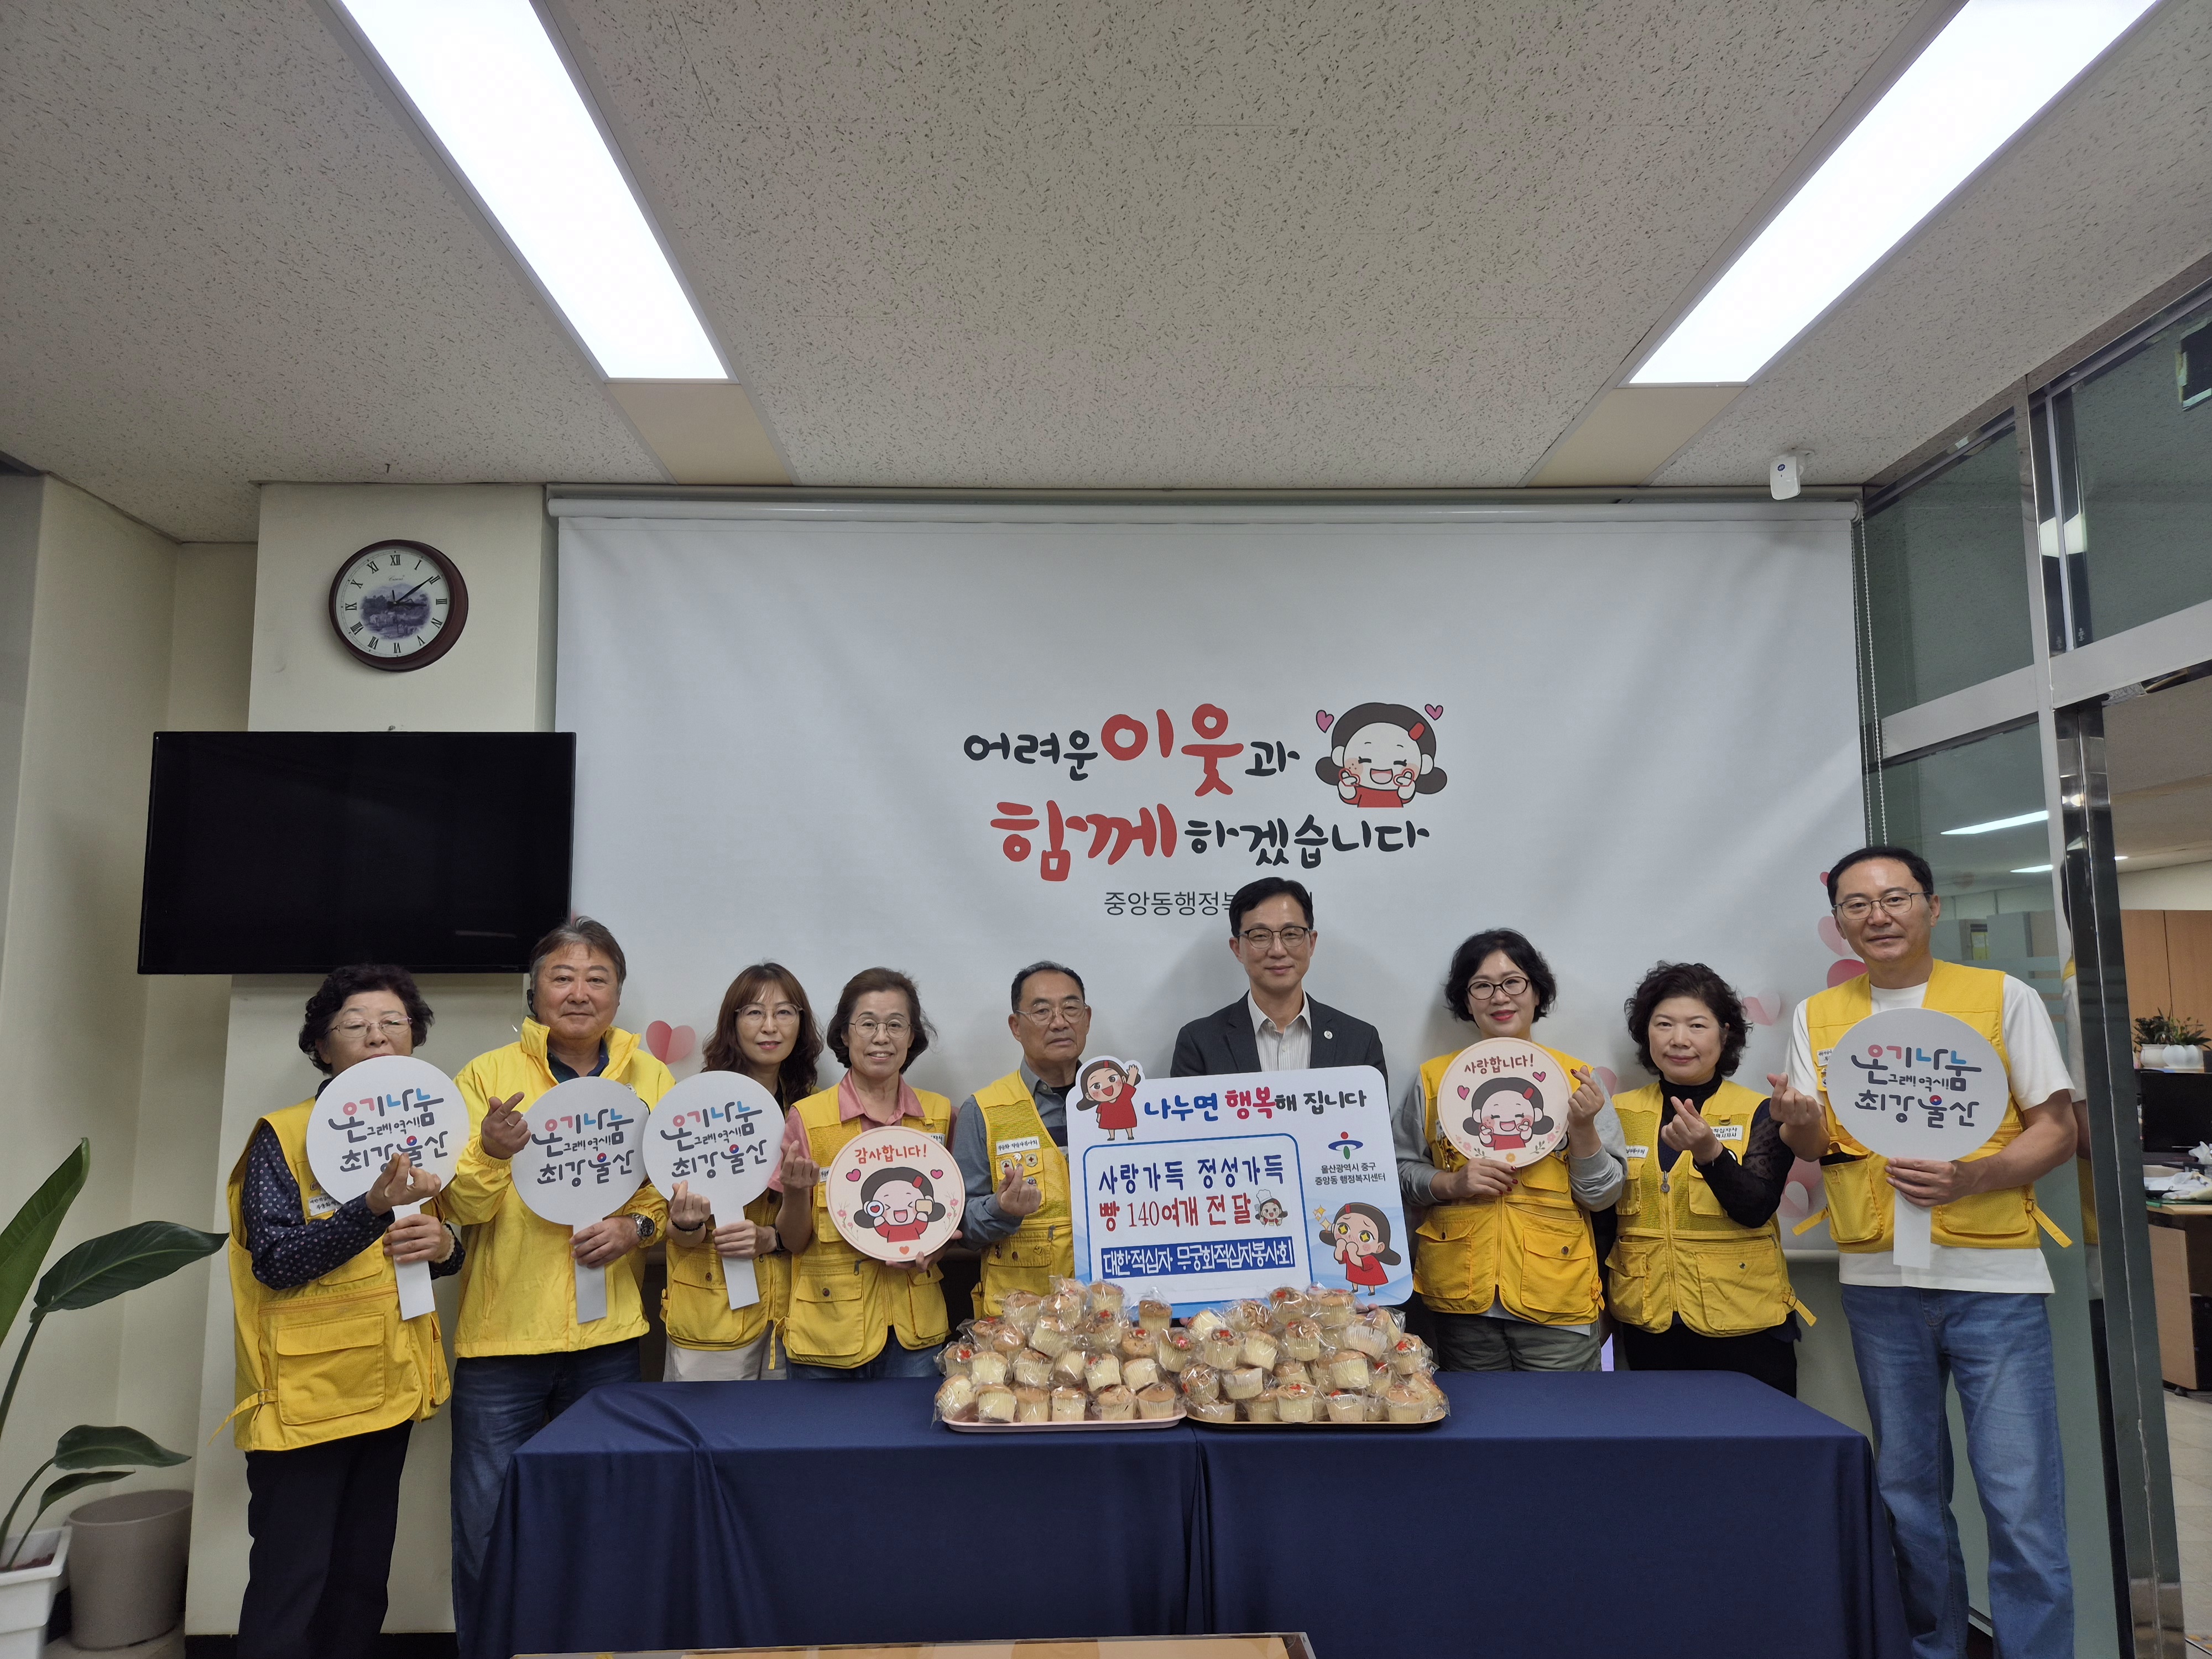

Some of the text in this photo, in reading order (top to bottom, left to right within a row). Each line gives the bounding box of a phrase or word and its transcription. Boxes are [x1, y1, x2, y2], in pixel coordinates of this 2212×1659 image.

[367, 561, 379, 574] XI
[390, 555, 401, 566] XII
[350, 579, 363, 589] X
[345, 602, 357, 611] IX
[350, 622, 364, 635] VIII
[368, 637, 379, 650] VII
[393, 643, 401, 654] VI
[417, 635, 425, 646] V
[964, 703, 1300, 796] 어려운 이웃과
[1463, 1053, 1534, 1075] 사랑합니다!
[1888, 1075, 1949, 1092] 그래! 역시!
[1144, 1086, 1366, 1122] 나누면 행복해 집니다
[367, 1119, 421, 1136] 그래! 역시!
[564, 1136, 611, 1152] 그래! 역시!
[694, 1129, 742, 1145] 그래! 역시!
[854, 1144, 927, 1164] 감사합니다!
[1099, 1154, 1284, 1194] 사랑가득 정성가득
[1321, 1162, 1376, 1173] 울산광역시 중구
[1315, 1172, 1385, 1185] 중앙동 행정복지센터
[1099, 1203, 1120, 1232] 빵
[1128, 1198, 1199, 1228] 140여개
[1103, 1238, 1294, 1276] 대한적십자 무궁화적십자봉사회
